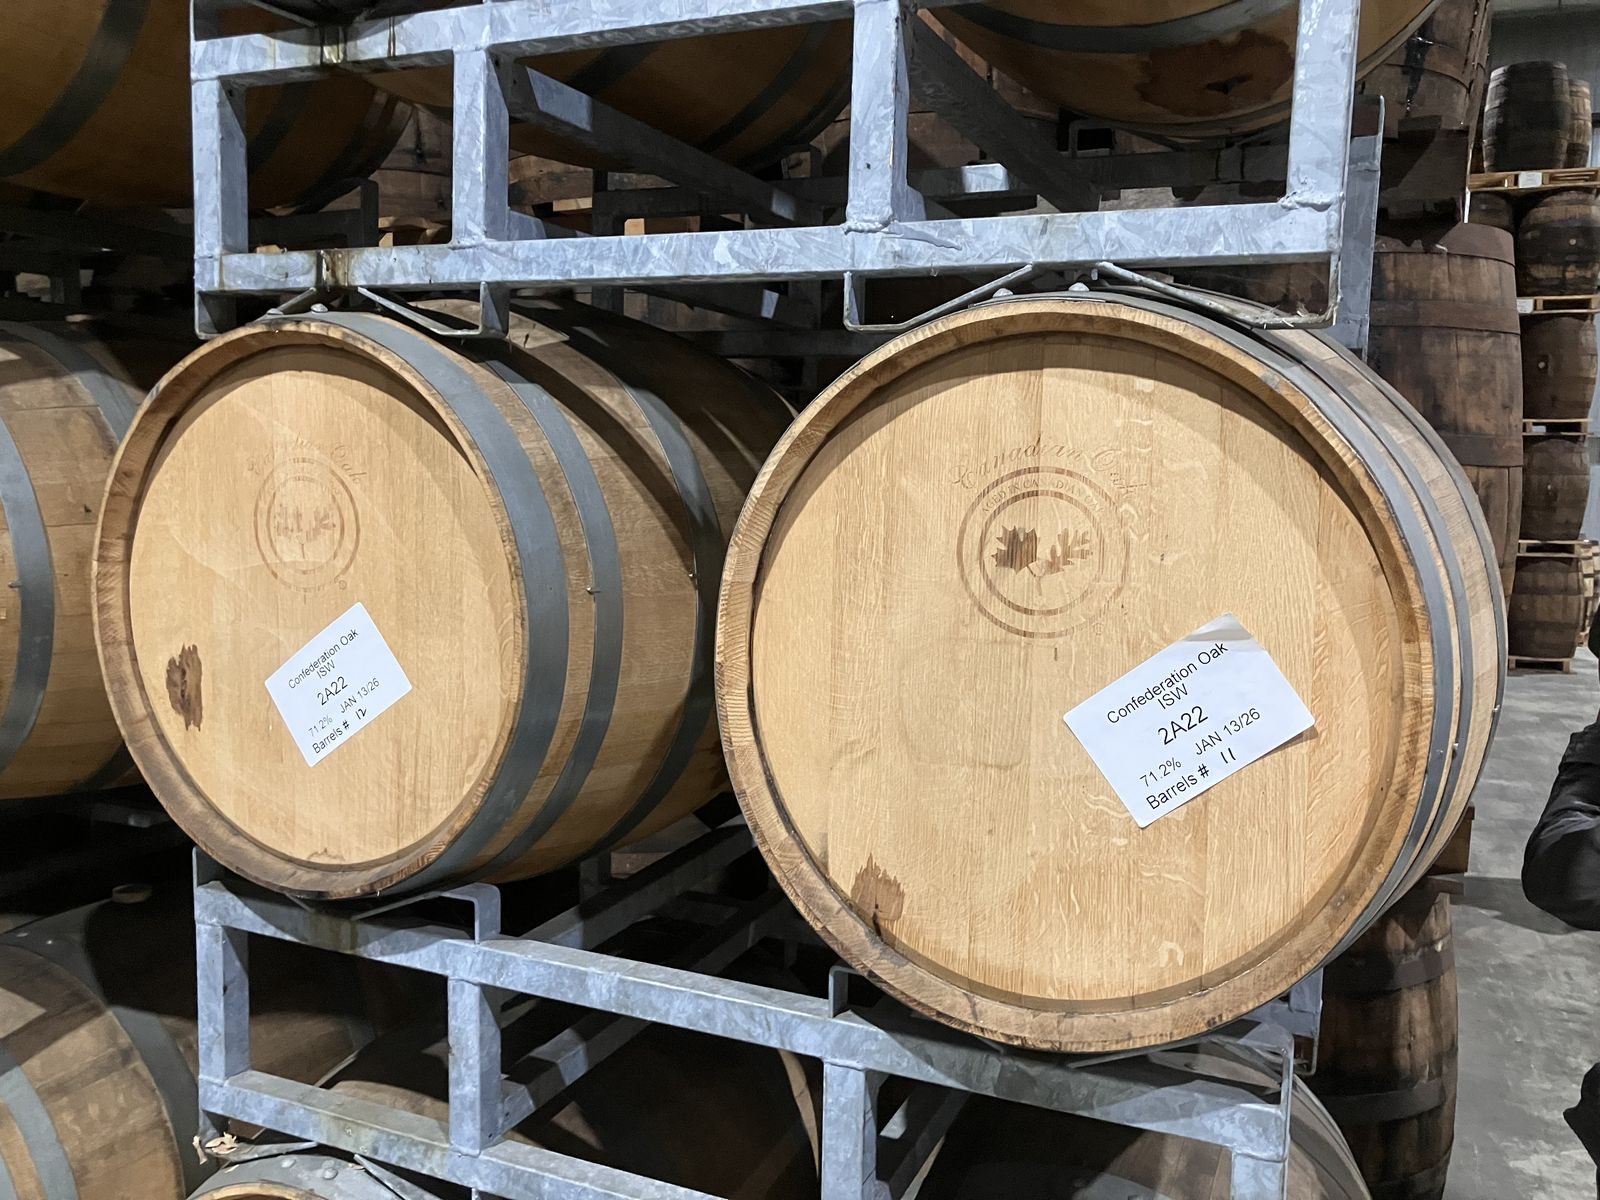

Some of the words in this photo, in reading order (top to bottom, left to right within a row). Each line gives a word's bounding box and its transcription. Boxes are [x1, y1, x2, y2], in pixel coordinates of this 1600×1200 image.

[288, 644, 341, 689] Confederation
[340, 628, 359, 646] Oak
[316, 659, 336, 679] ISW
[317, 676, 348, 706] 2A22
[339, 696, 357, 714] JAN
[357, 677, 380, 700] 13/26
[1107, 662, 1198, 724] Confederation
[1197, 642, 1229, 665] Oak
[1157, 683, 1189, 709] ISW
[312, 726, 343, 754] Barrels
[342, 719, 350, 731] #
[355, 706, 368, 720] 12
[1139, 757, 1182, 787] 71.2%
[1195, 731, 1223, 755] JAN
[1223, 707, 1261, 737] 13/26
[1157, 705, 1208, 745] 2A22
[1146, 773, 1198, 810] Barrels
[1197, 763, 1210, 778] #
[1220, 747, 1237, 764] 11
